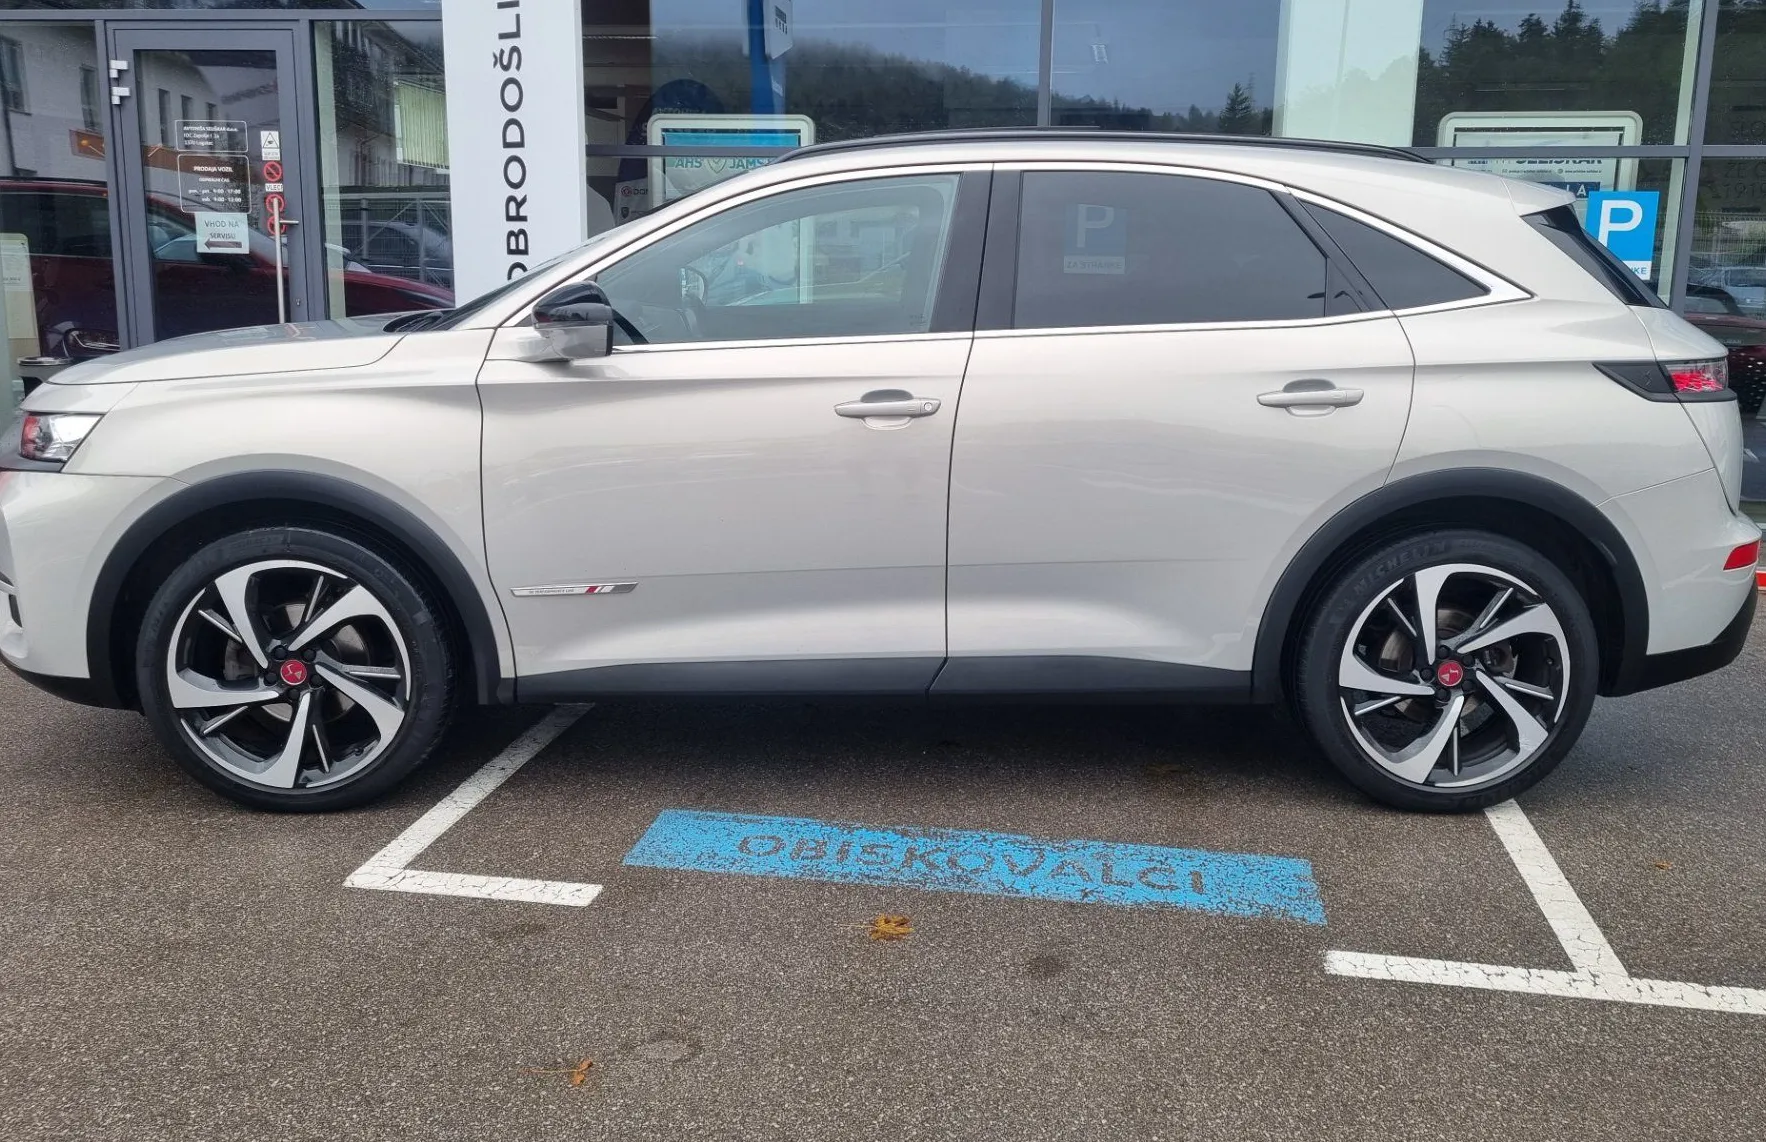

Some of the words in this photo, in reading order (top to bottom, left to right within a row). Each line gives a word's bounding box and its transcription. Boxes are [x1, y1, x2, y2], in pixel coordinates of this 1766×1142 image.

[204, 220, 227, 228] VHOD
[228, 220, 240, 228] NA
[1077, 203, 1114, 248] P
[1598, 199, 1643, 249] P
[738, 834, 1205, 895] OBISKOVALCI
